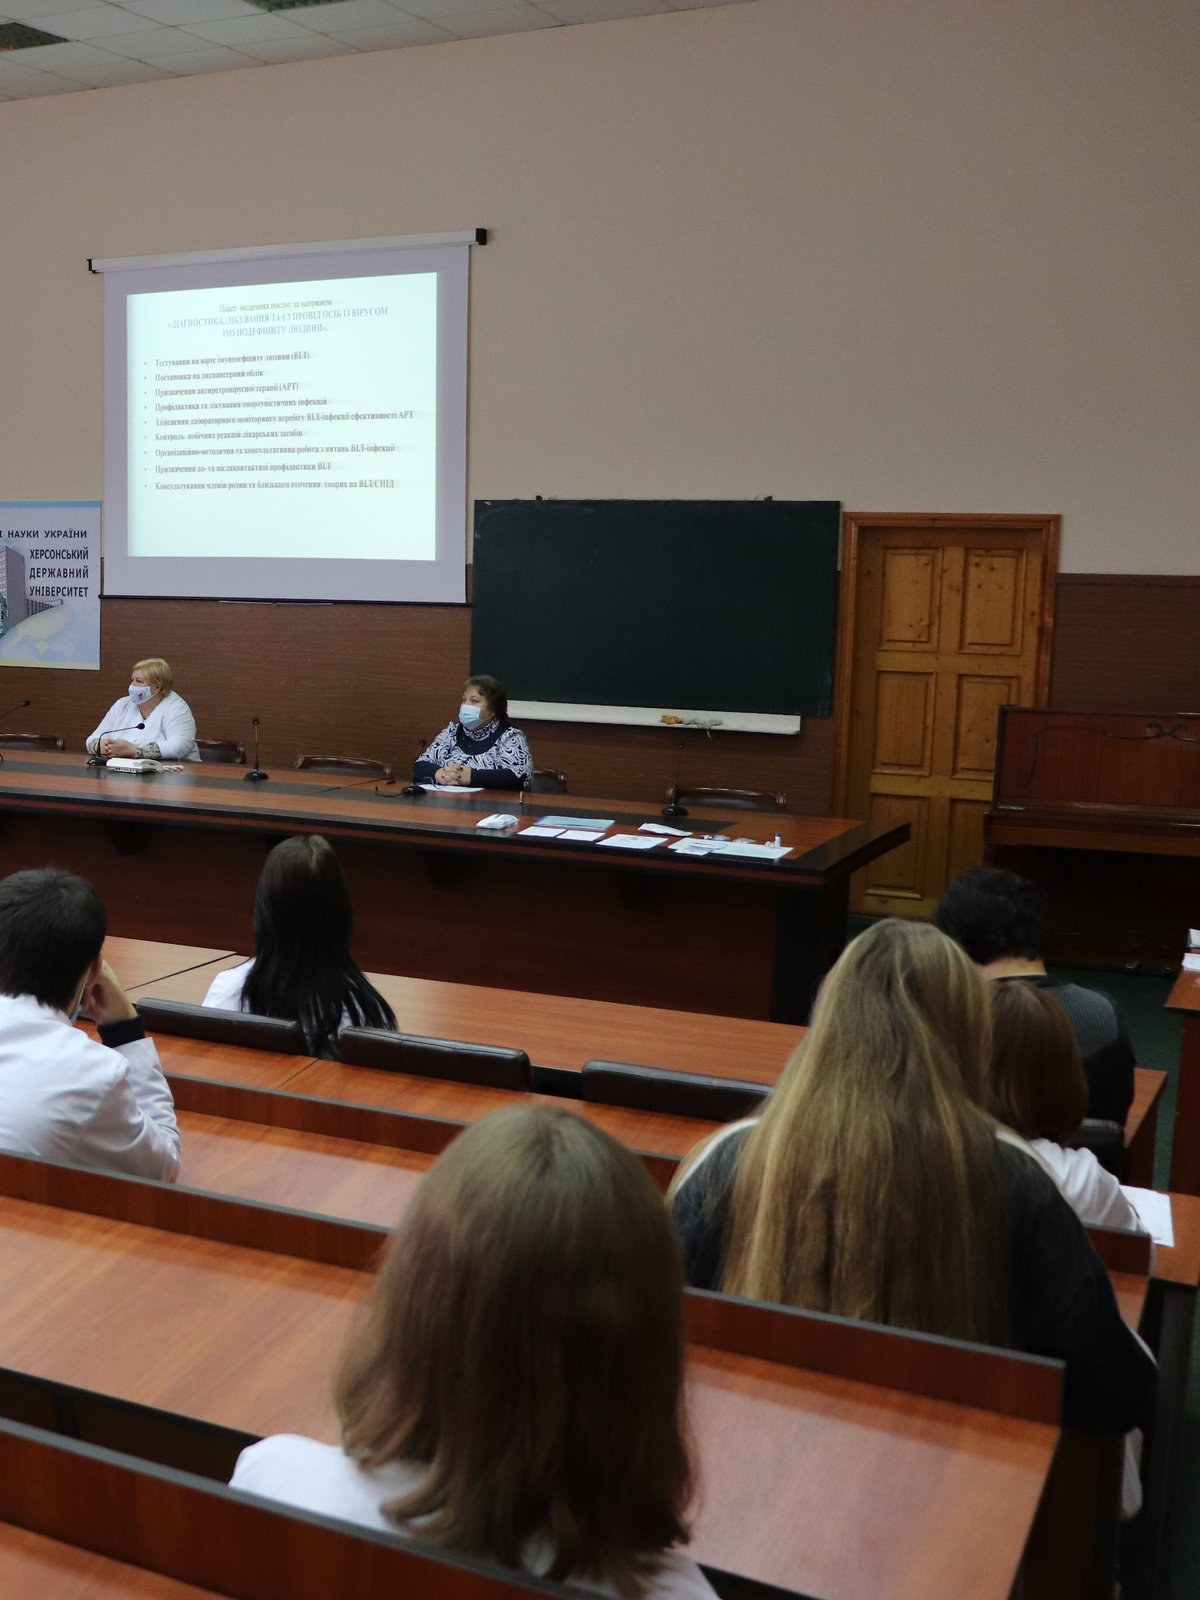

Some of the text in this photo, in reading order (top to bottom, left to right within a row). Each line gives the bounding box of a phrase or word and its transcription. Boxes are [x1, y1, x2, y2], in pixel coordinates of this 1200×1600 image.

[272, 314, 280, 323] ТА
[282, 310, 320, 322] СУПРОВІД
[322, 309, 341, 319] ОСІБ
[343, 308, 351, 318] ІЗ
[352, 307, 388, 317] ВІРУСОМ
[156, 374, 191, 382] Постановка
[246, 369, 264, 377] облік
[156, 388, 196, 398] Призначення
[280, 382, 298, 391] (АРТ)
[156, 402, 199, 412] Профілактика
[398, 410, 414, 419] АРТ
[297, 444, 318, 455] робота
[156, 466, 196, 474] Призначення
[270, 462, 316, 472] профілактики
[8, 530, 39, 538] НАУКИ
[44, 528, 88, 538] УКРАЇНИ
[30, 546, 88, 560] ХЕРСОНСЬКИЙ
[29, 566, 88, 579] ДЕРЖАВНИЙ
[30, 586, 88, 598] УНІВЕРСИТЕТ
